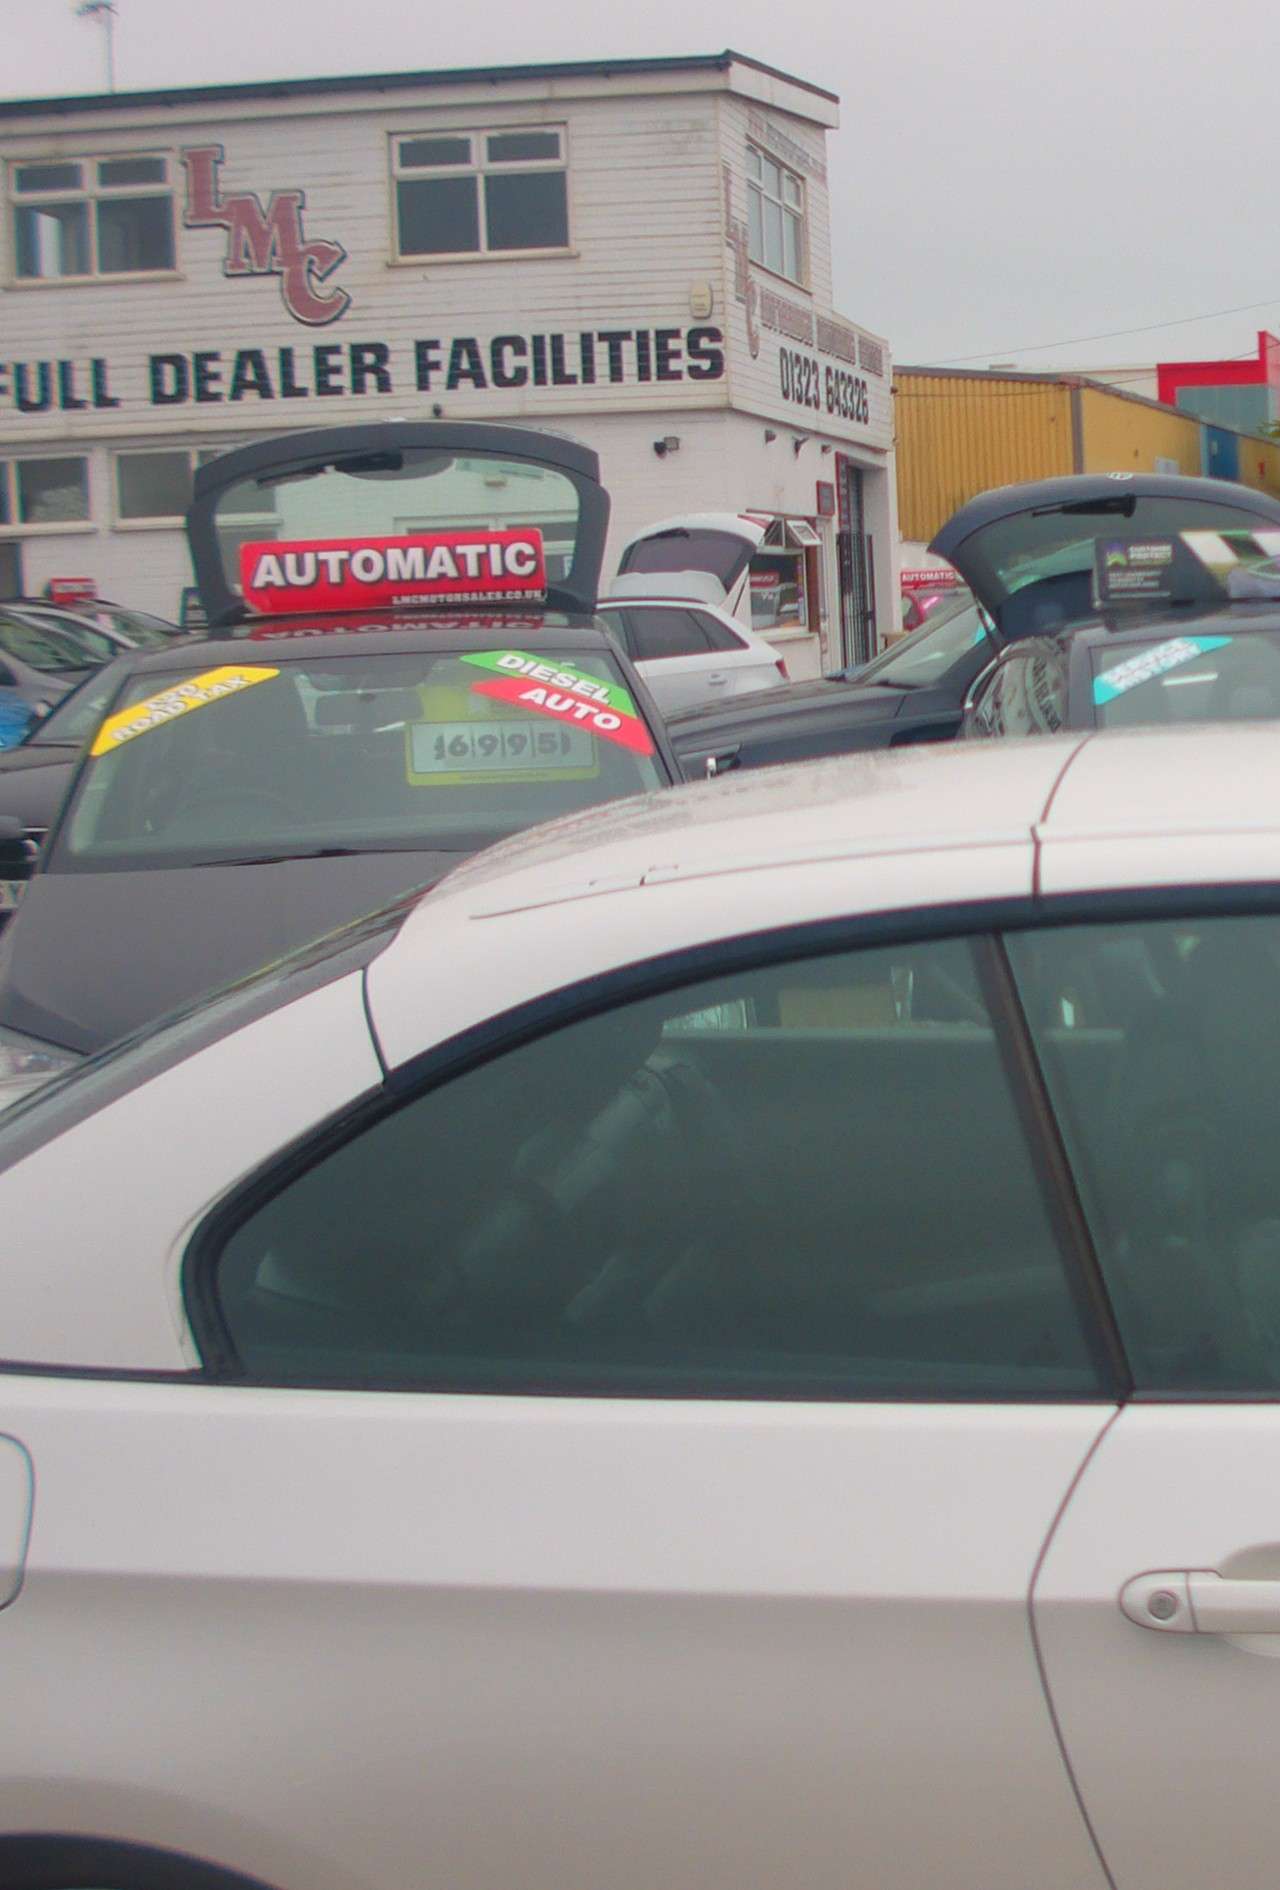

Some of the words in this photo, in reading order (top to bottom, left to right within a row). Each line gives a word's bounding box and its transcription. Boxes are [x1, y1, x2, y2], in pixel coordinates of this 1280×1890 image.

[183, 144, 352, 326] LMC
[149, 342, 393, 405] DEALER
[414, 326, 725, 392] FACILITIES
[779, 347, 821, 411] 01323
[251, 541, 539, 588] AUTOMATIC
[496, 654, 612, 704] DIESEL
[518, 687, 622, 731] AUTO
